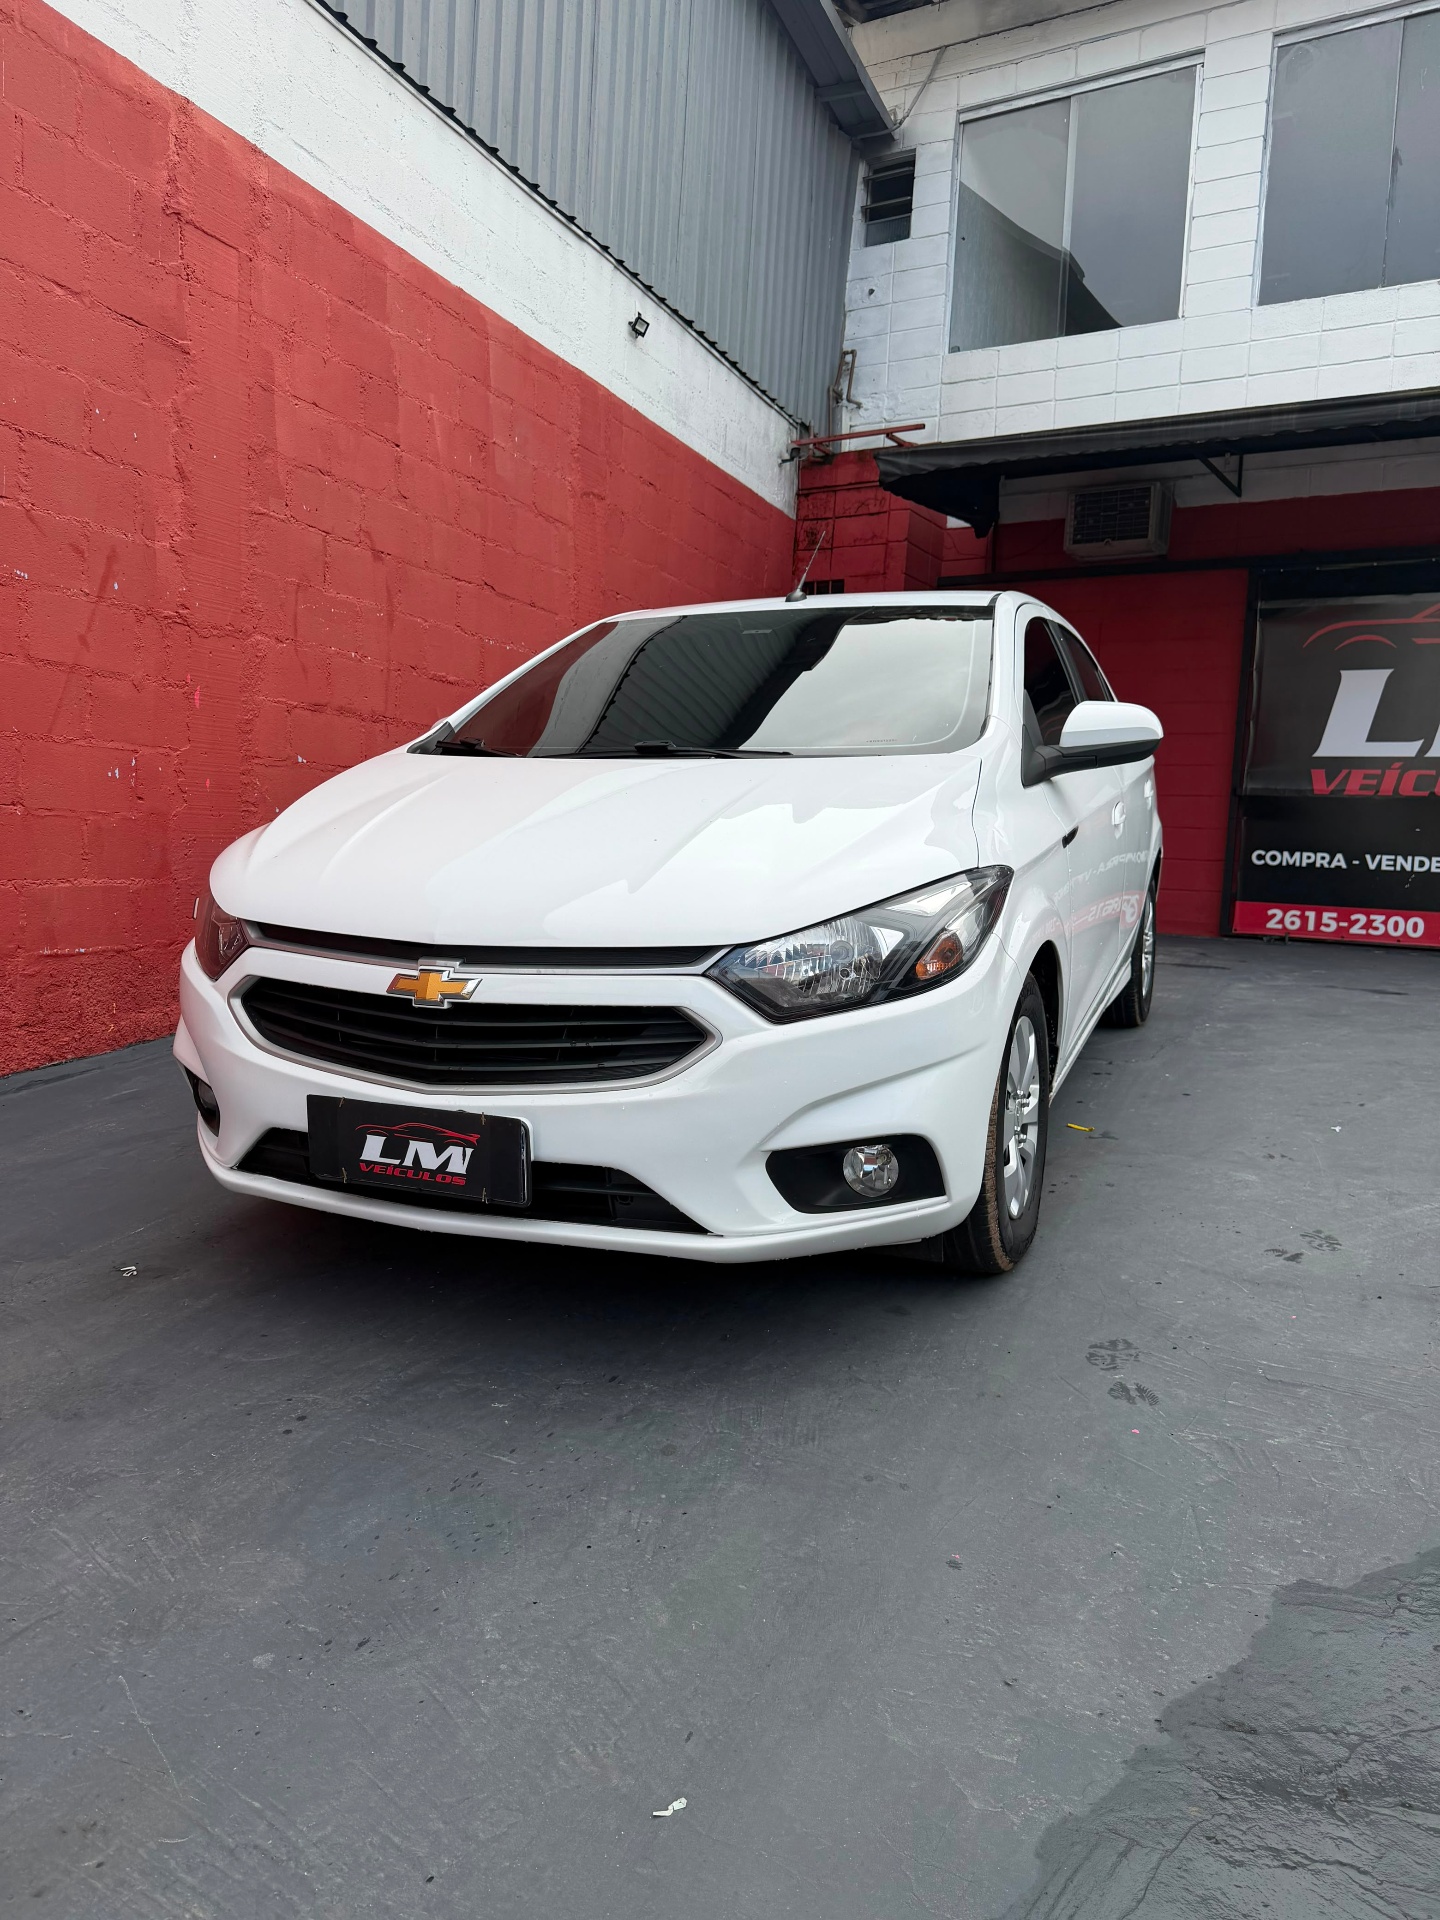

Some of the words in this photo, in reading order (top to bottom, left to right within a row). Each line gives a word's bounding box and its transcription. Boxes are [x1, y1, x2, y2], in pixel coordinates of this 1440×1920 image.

[1311, 668, 1440, 758] L
[1310, 762, 1440, 797] VEÍC
[1250, 849, 1347, 870] COMPRA
[1364, 853, 1440, 874] VENDE
[1265, 908, 1426, 939] 2615-2300
[359, 1134, 475, 1175] LM
[359, 1162, 467, 1186] VEÍCULOS
